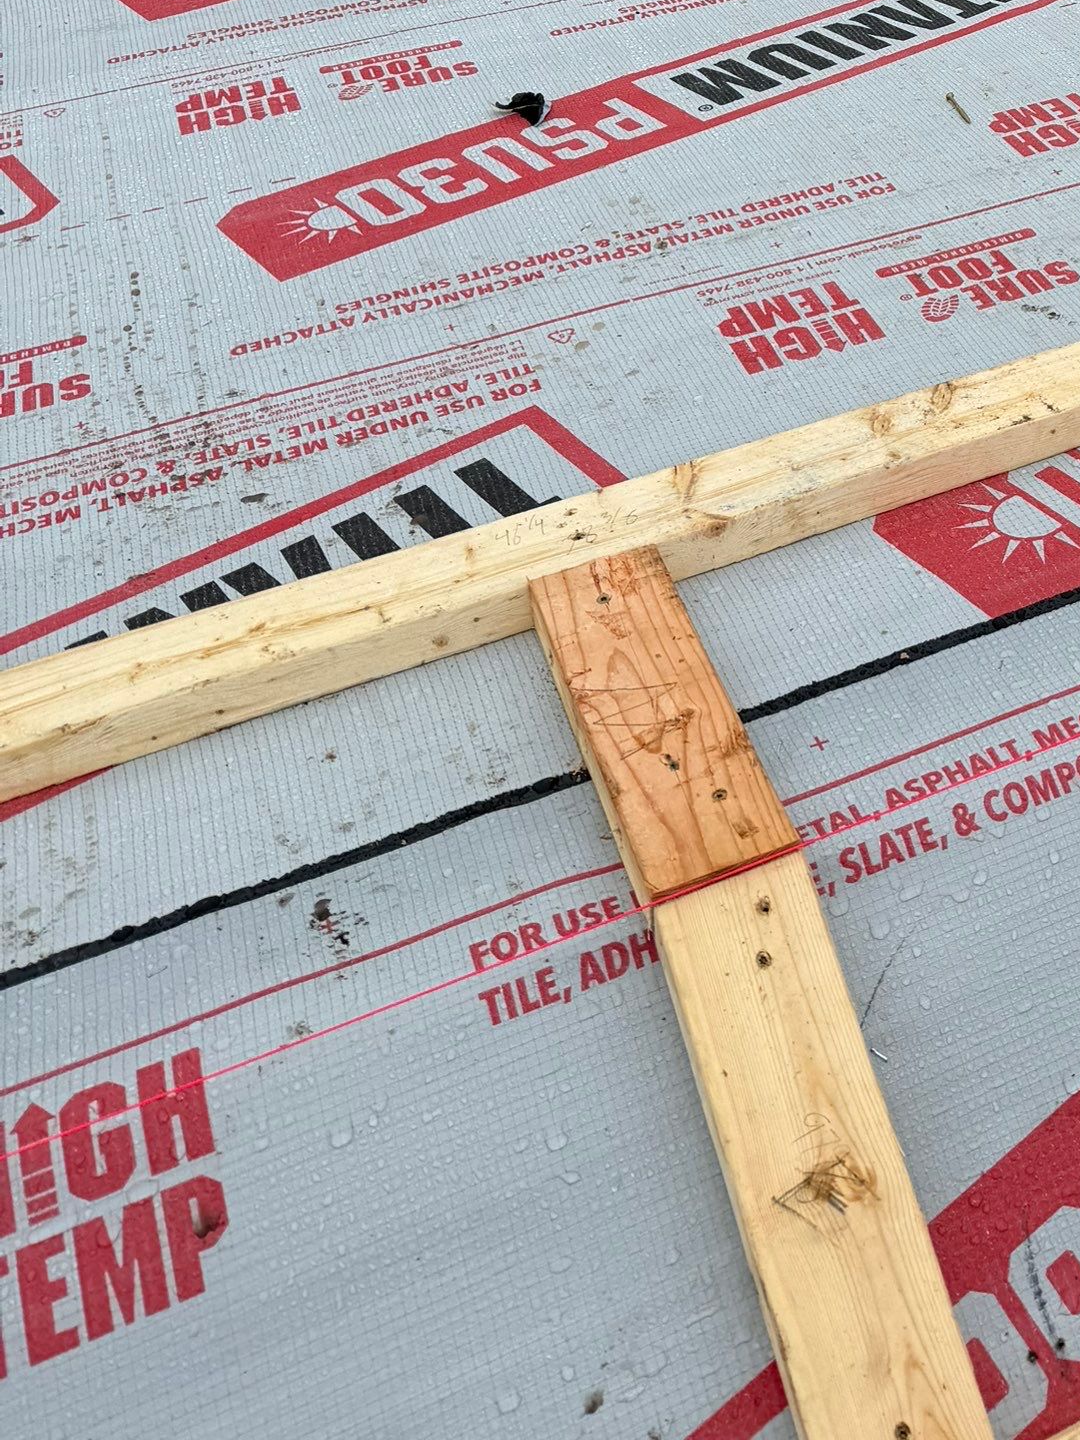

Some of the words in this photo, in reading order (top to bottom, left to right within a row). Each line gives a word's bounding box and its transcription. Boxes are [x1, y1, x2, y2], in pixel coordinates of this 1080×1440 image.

[186, 18, 274, 41] SHINGLES
[205, 14, 335, 44] MECHANICALLY
[549, 13, 636, 37] ATTACHED
[106, 41, 203, 65] ATTACHED
[339, 55, 433, 86] FOOT
[377, 61, 480, 93] SURE
[174, 76, 297, 113] TEMP
[176, 92, 302, 137] HIGH
[334, 96, 669, 228] PSU30
[740, 183, 835, 217] ADHERED
[811, 192, 853, 211] USE
[854, 181, 896, 200] FOR
[736, 205, 811, 229] UNDER
[456, 243, 589, 286] COMPOSITE
[547, 241, 653, 274] ASPHALT,
[903, 250, 1016, 299] FOOT
[334, 281, 451, 315] SHINGLES
[361, 270, 545, 326] MECHANICALLY
[958, 260, 1080, 312] SURE
[716, 280, 861, 339] TEMP
[229, 315, 356, 358] ATTACHED
[728, 307, 887, 376] HIGH
[474, 362, 536, 386] TILE,
[488, 378, 542, 402] FOR
[345, 379, 470, 423] ADHERED
[433, 394, 485, 418] USE
[278, 415, 342, 440] TILE,
[334, 409, 430, 448] UNDER
[183, 433, 272, 466] SLATE,
[155, 459, 177, 477] &
[794, 803, 881, 845] ETAL,
[883, 736, 1035, 811] ASPHALT,
[841, 816, 950, 887] SLATE,
[951, 801, 982, 840] &
[468, 921, 549, 972] FOR
[552, 896, 622, 939] USE
[478, 966, 573, 1027] TILE,
